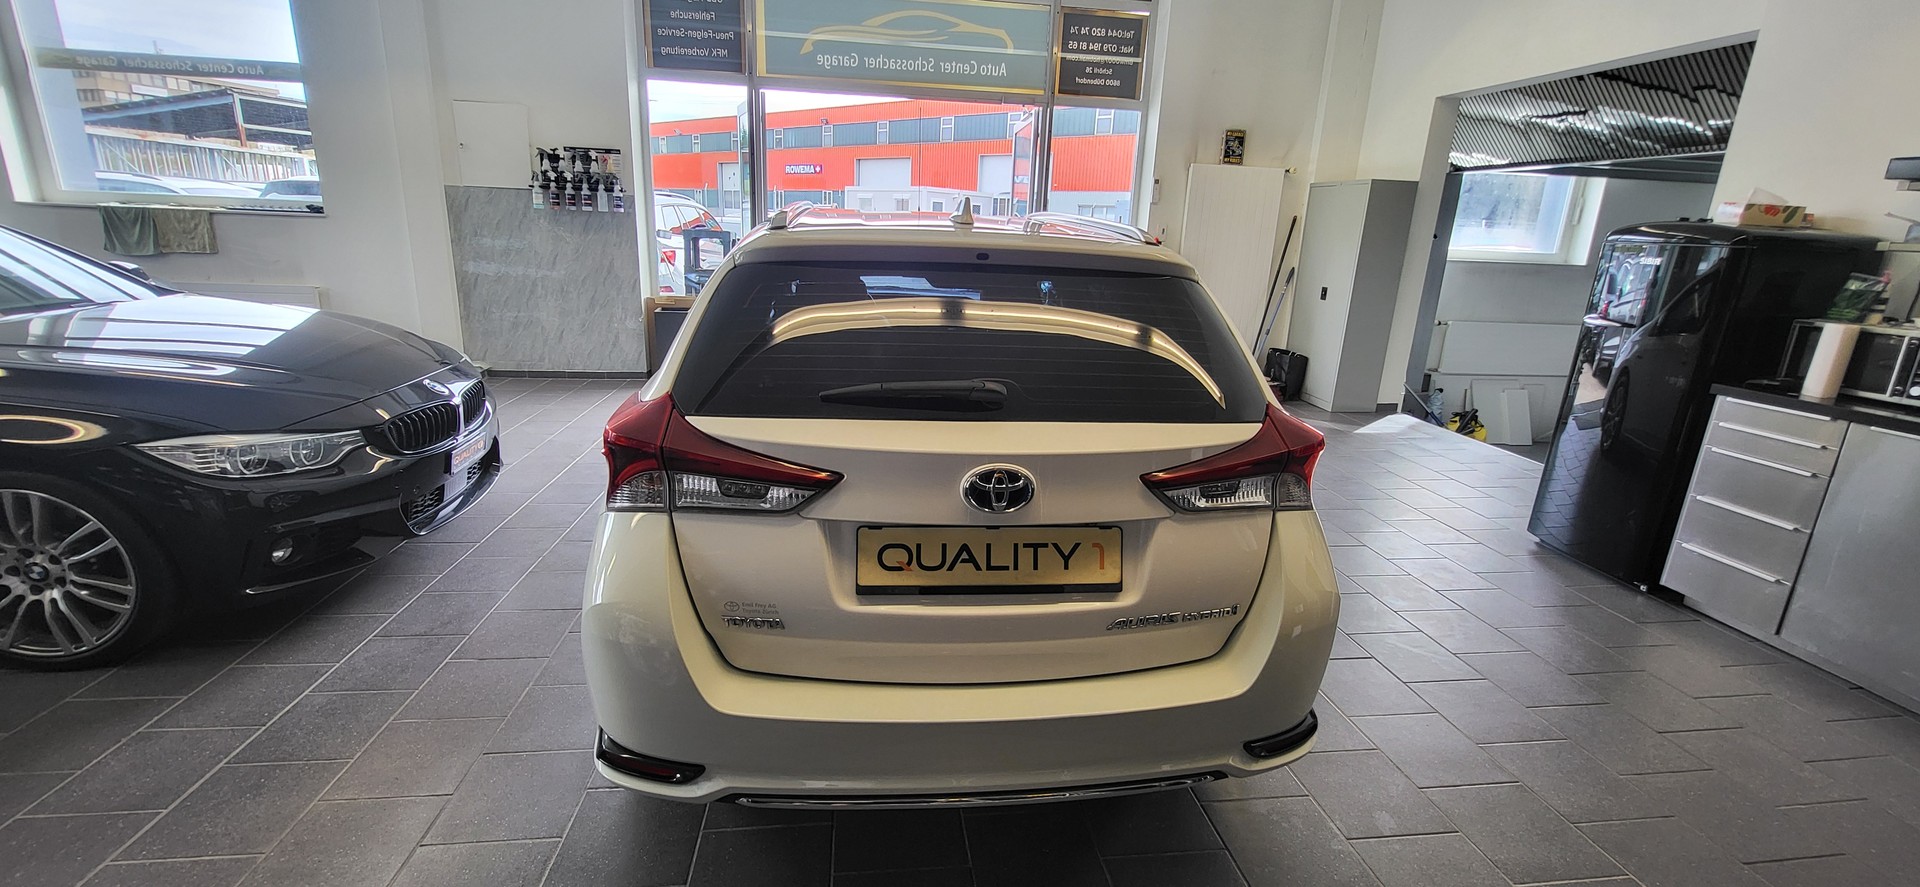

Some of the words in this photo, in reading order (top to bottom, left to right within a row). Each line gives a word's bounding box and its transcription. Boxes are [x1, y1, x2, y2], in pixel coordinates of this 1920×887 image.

[785, 165, 815, 174] ROWEMA
[877, 542, 1082, 572] QUALITY
[1091, 542, 1105, 571] 1
[720, 614, 786, 630] TOYOTA
[1106, 611, 1181, 631] AURIS
